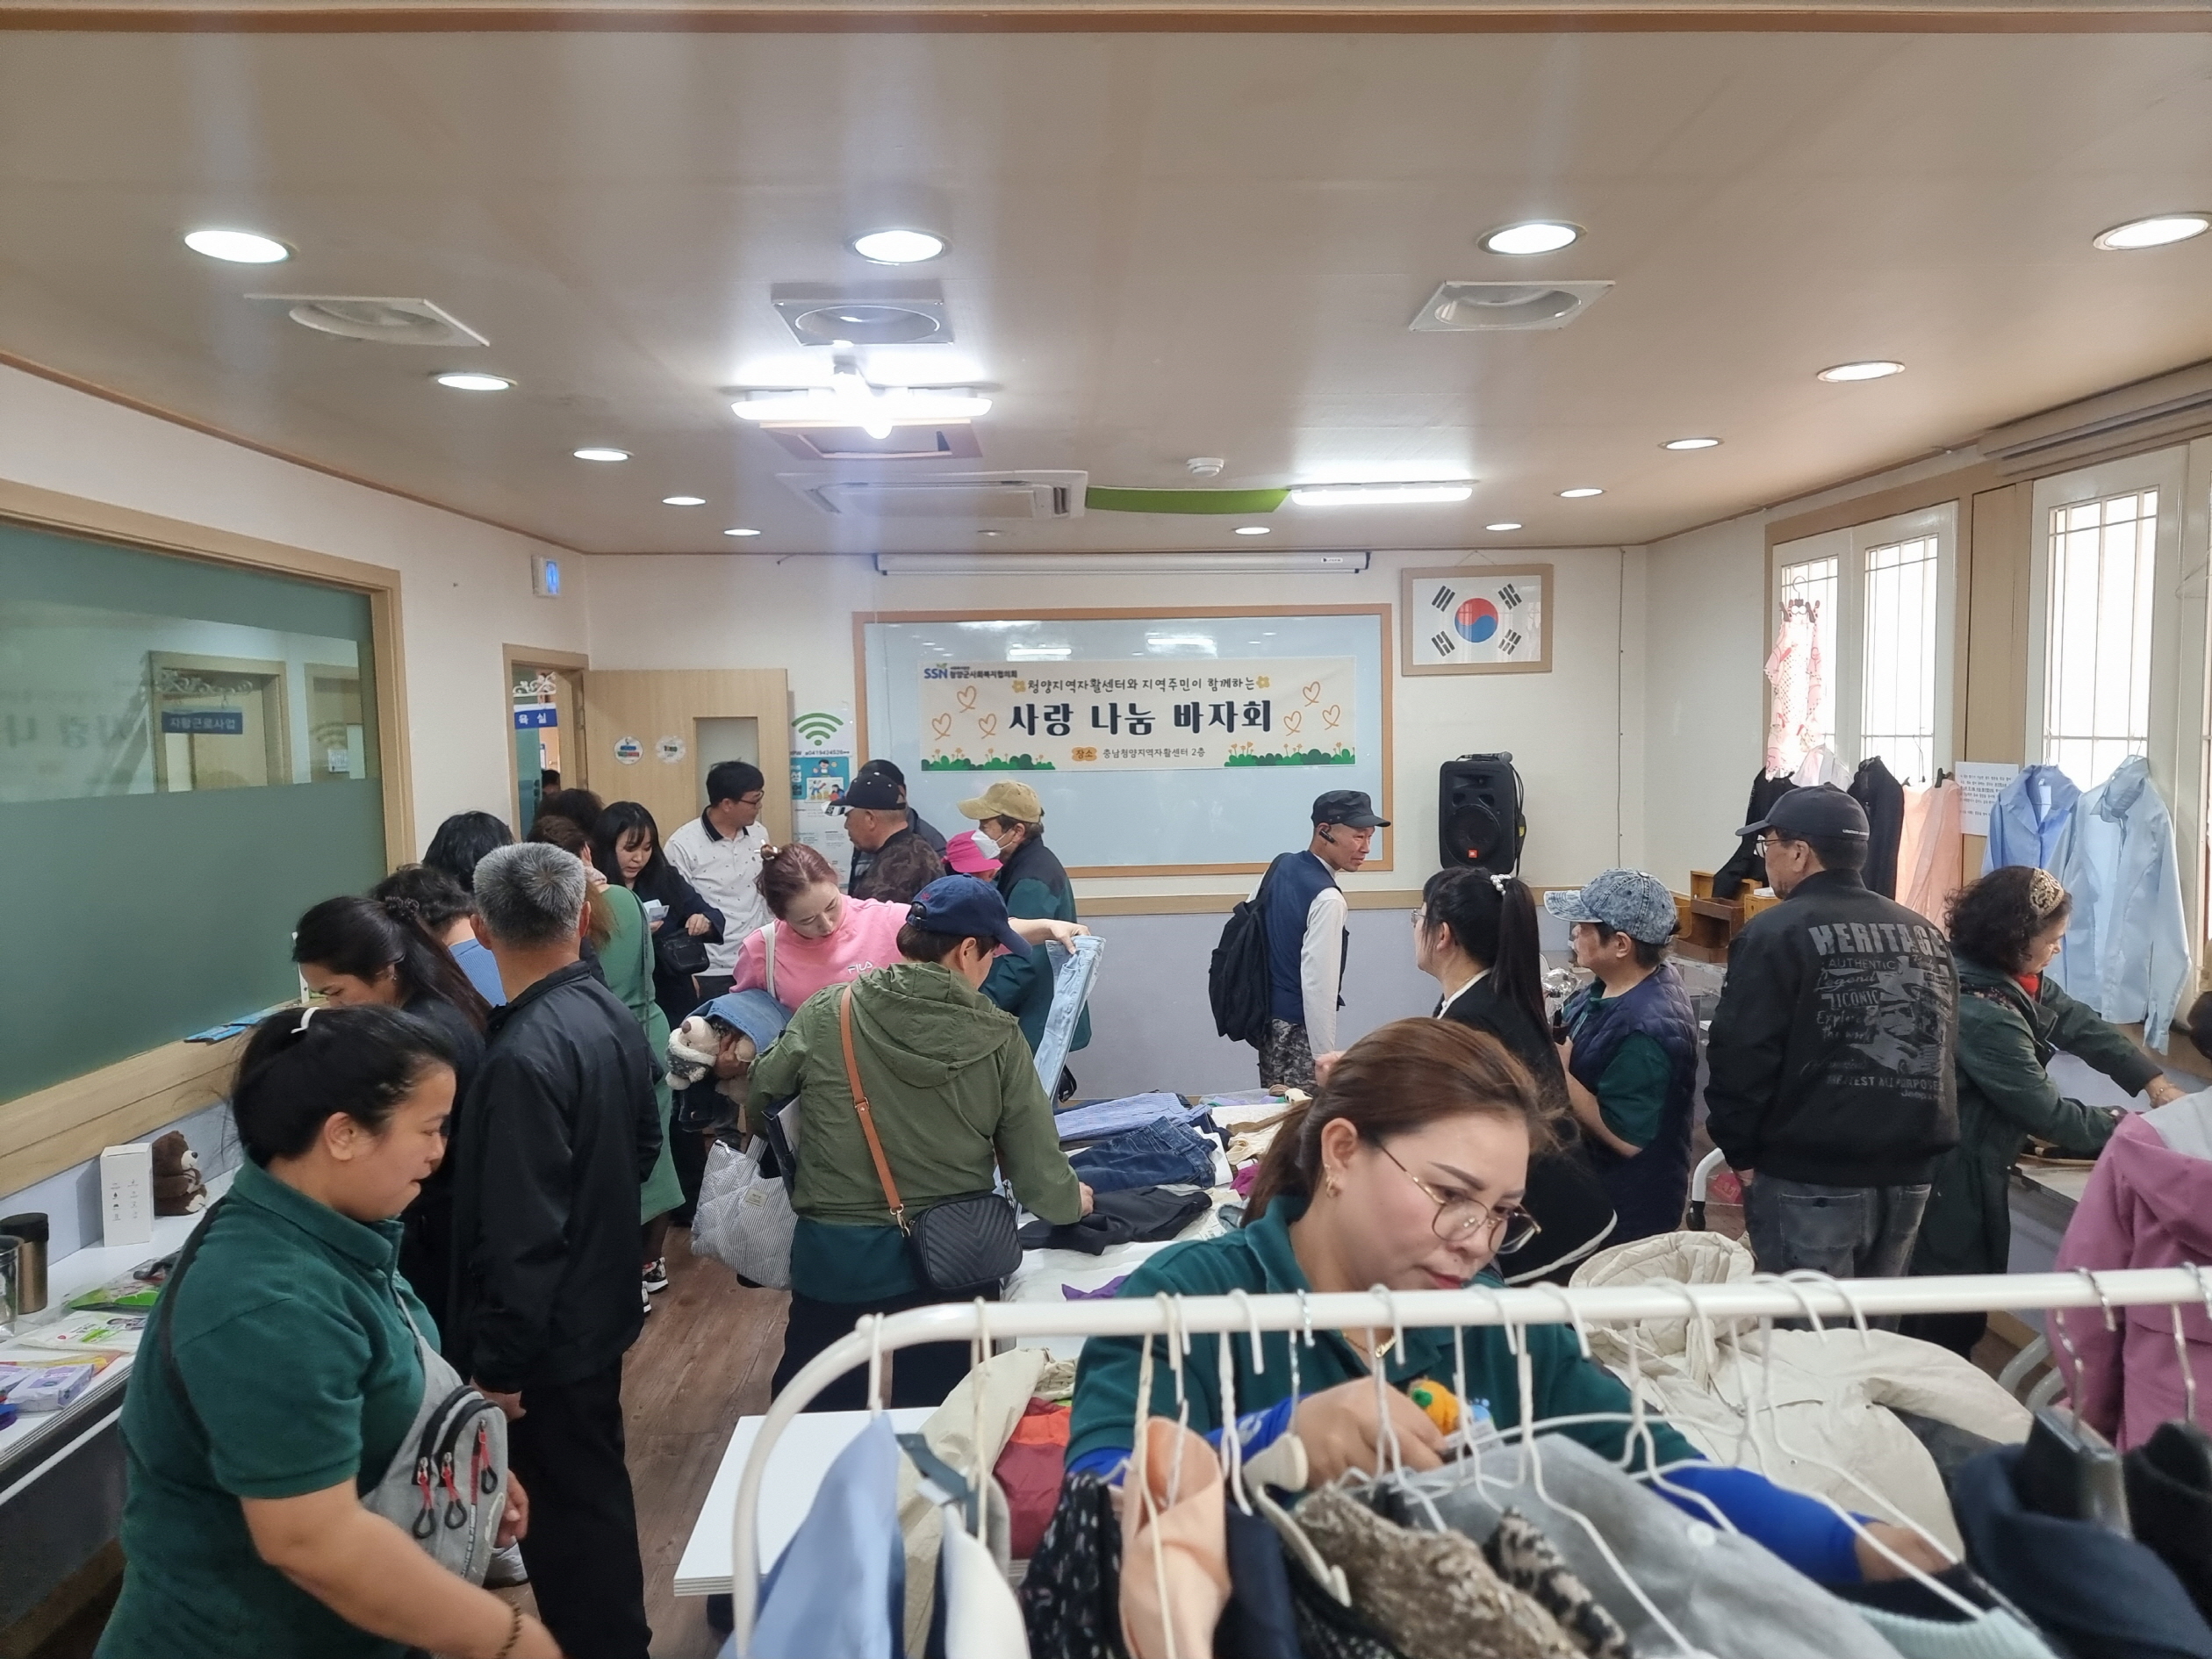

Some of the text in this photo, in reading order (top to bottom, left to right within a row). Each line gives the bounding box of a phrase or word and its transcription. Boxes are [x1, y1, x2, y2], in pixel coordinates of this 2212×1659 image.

[923, 668, 948, 679] SSN
[1028, 676, 1255, 693] 청양지역자활센터와 지역주민이 함께하는
[1009, 700, 1271, 736] 사랑 나눔 바자회
[1076, 749, 1094, 759] 장소
[1102, 747, 1206, 758] 충남청양지역자활센터 2층
[1808, 923, 1948, 959] HERITAGE
[847, 960, 873, 974] FILA
[1828, 958, 1896, 970] AUTHENTIC
